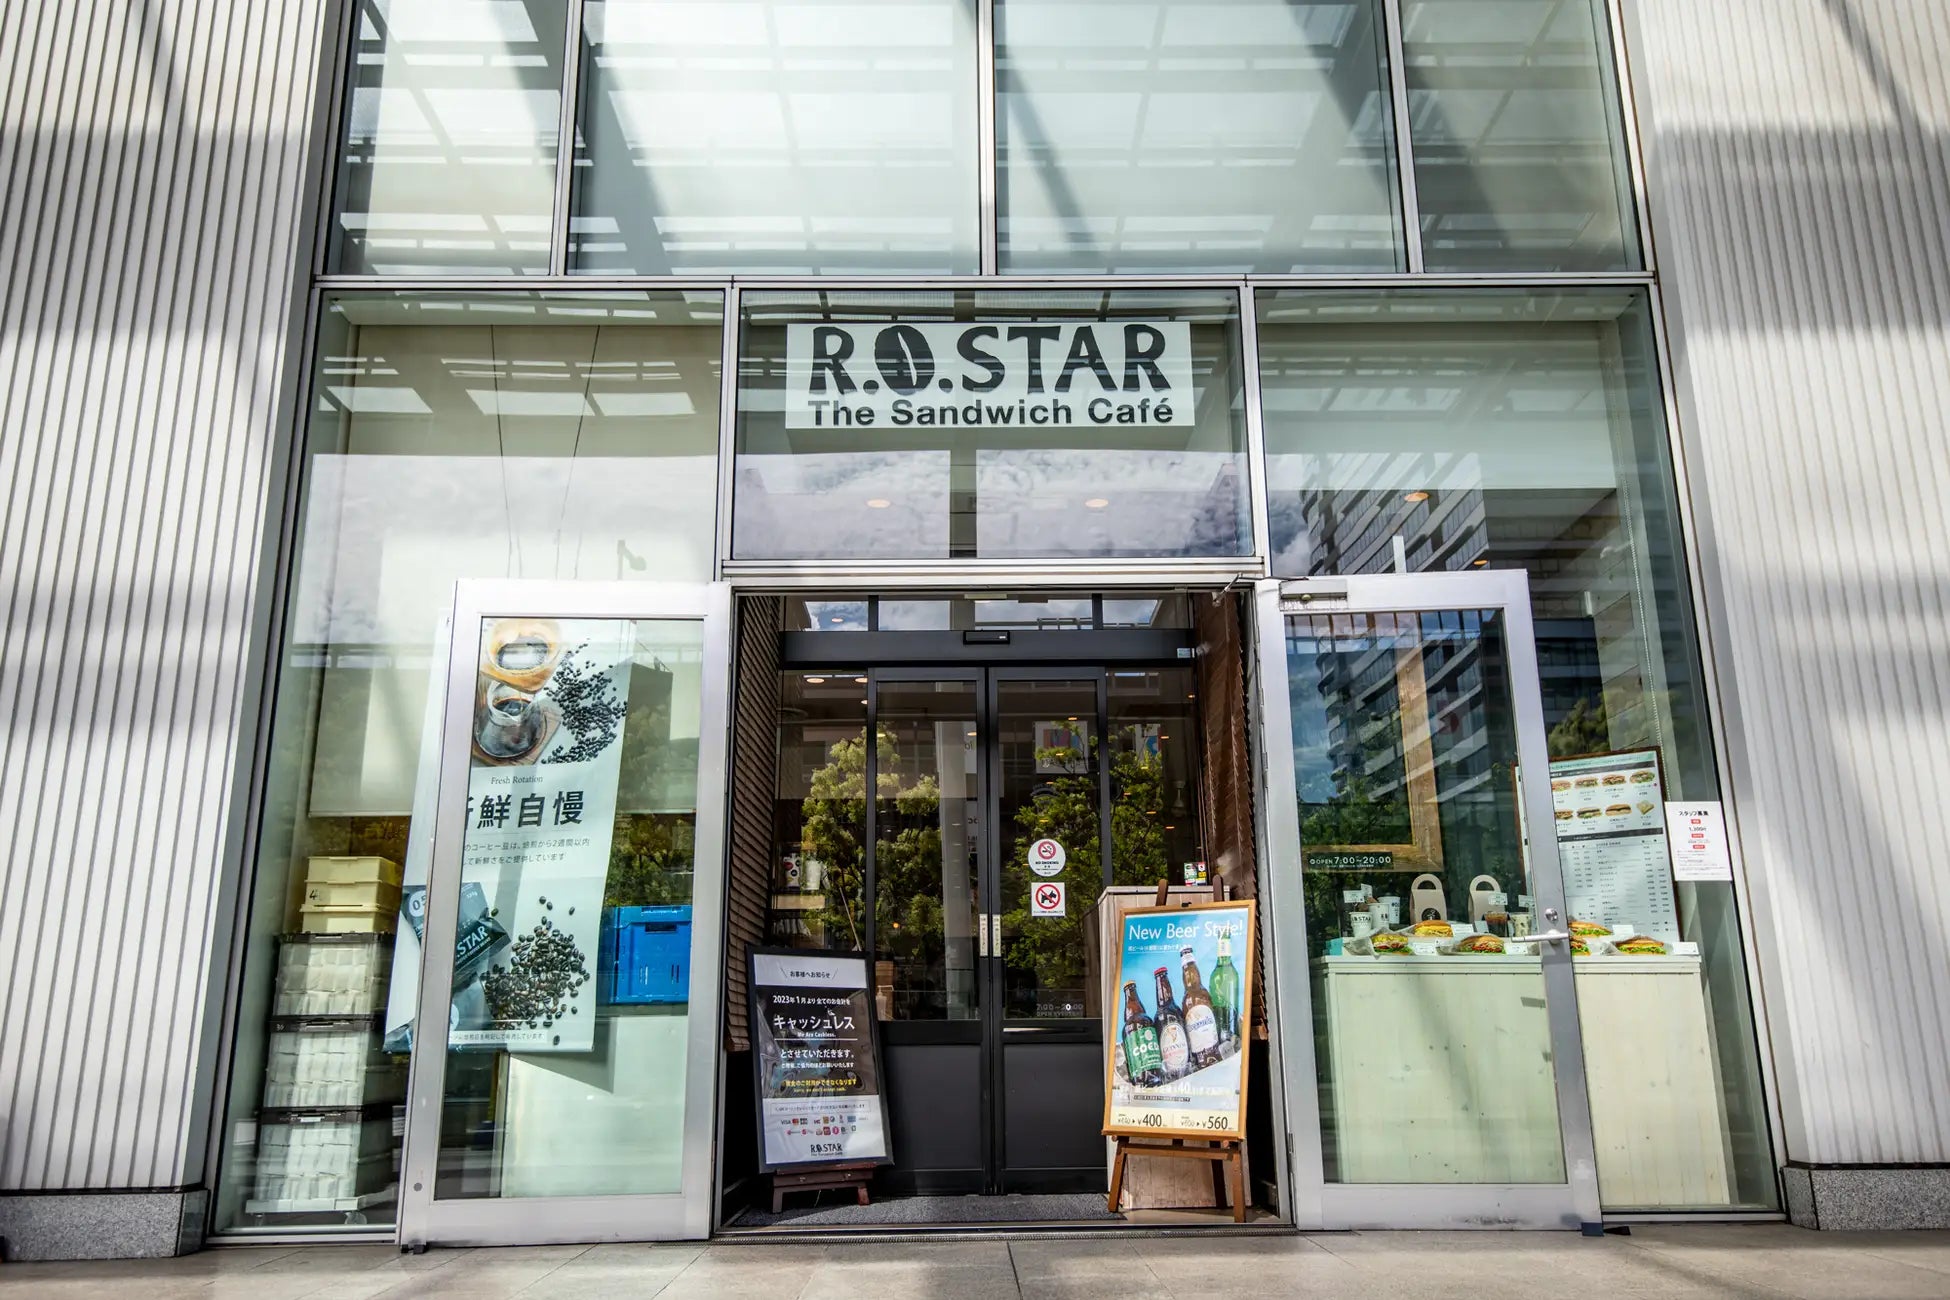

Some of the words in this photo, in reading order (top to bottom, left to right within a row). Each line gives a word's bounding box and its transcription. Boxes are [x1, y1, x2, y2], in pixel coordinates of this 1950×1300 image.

[808, 400, 875, 426] The
[890, 399, 1072, 426] Sandwich
[1088, 397, 1173, 425] Café
[490, 776, 511, 785] Fresh
[512, 775, 543, 784] Rotation
[1129, 924, 1162, 940] New
[1166, 923, 1199, 939] Beer
[1204, 919, 1243, 942] Style!
[789, 970, 831, 979] お客様へお知らせ
[772, 1014, 856, 1030] キャッシュレス
[780, 1049, 855, 1059] とさせていただきます。
